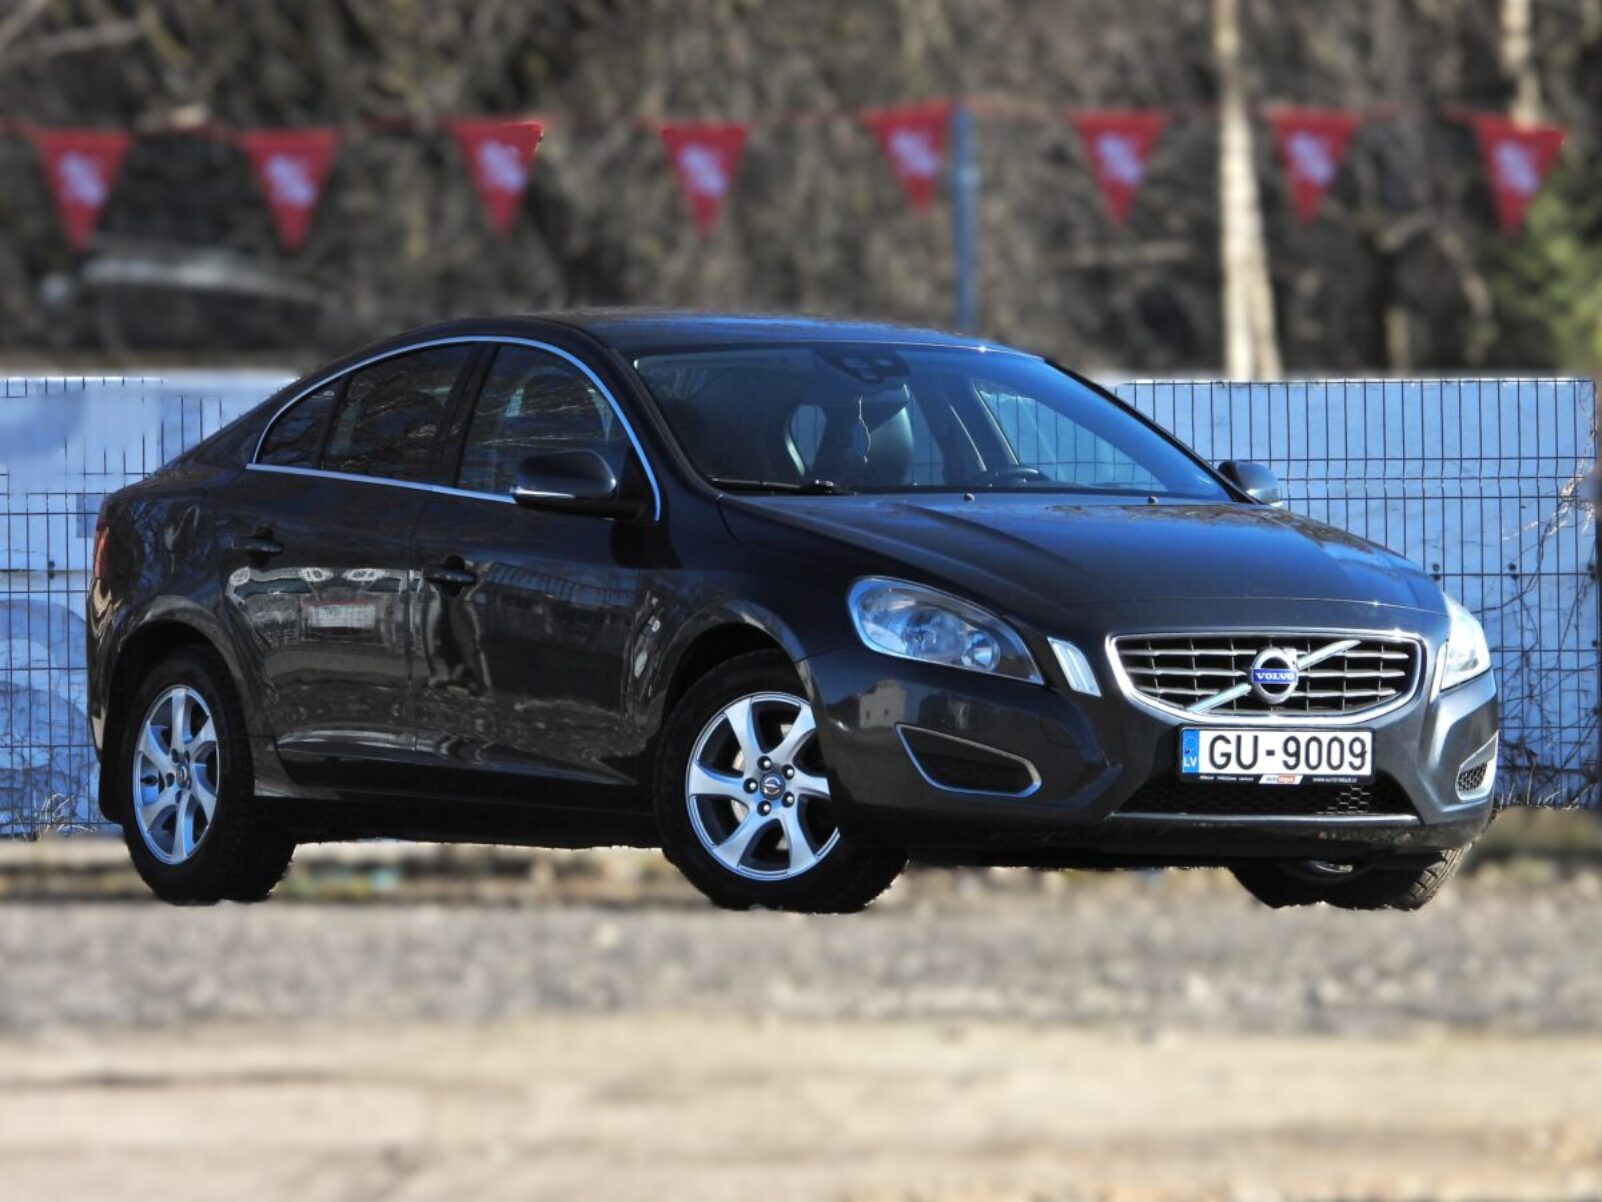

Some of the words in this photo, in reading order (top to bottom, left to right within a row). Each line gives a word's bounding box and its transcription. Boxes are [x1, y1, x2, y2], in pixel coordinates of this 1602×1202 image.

[1255, 672, 1294, 680] VOLVO
[1209, 734, 1367, 770] GU-9009
[1183, 756, 1197, 767] LV
